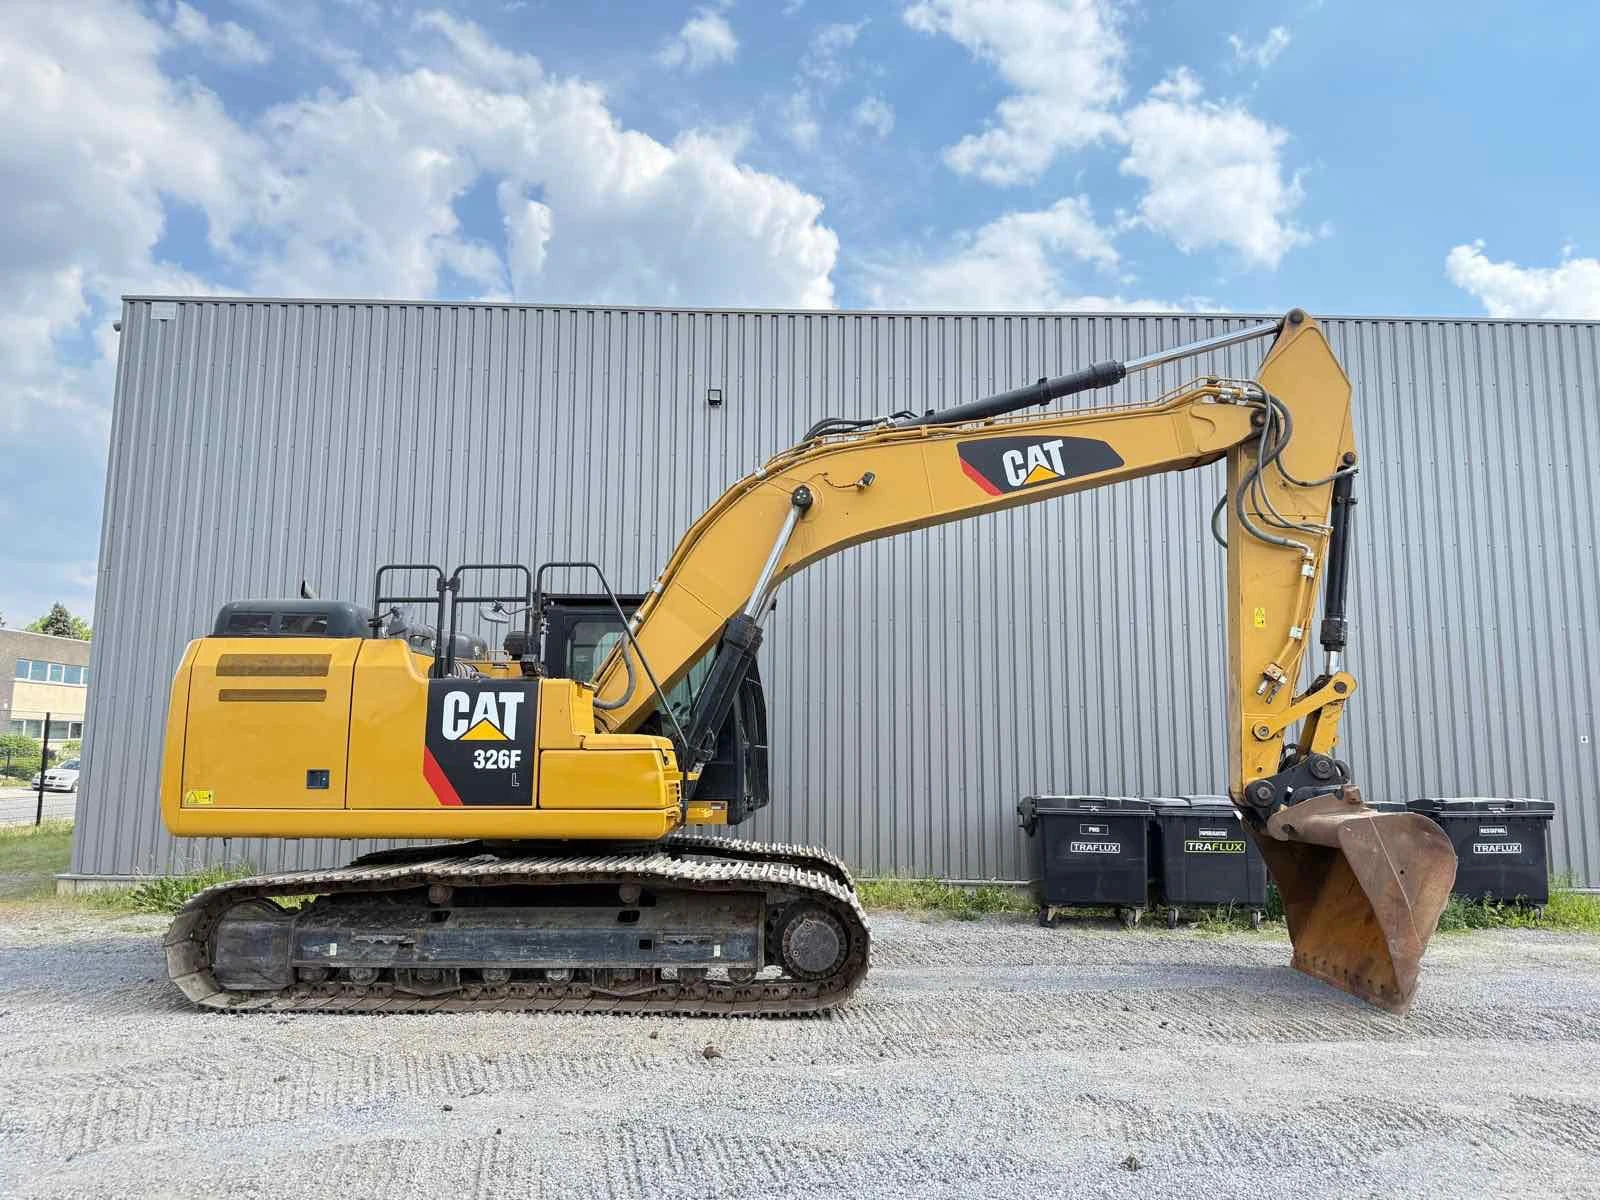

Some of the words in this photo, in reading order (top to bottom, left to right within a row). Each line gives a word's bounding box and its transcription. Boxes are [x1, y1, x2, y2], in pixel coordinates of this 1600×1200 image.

[1003, 440, 1065, 487] CAT
[442, 691, 524, 740] CAT
[473, 749, 521, 769] 326F
[1073, 843, 1118, 852] TRAFLUX
[1187, 842, 1242, 851] TRAFLUX
[1475, 844, 1519, 852] TRAFLUX
